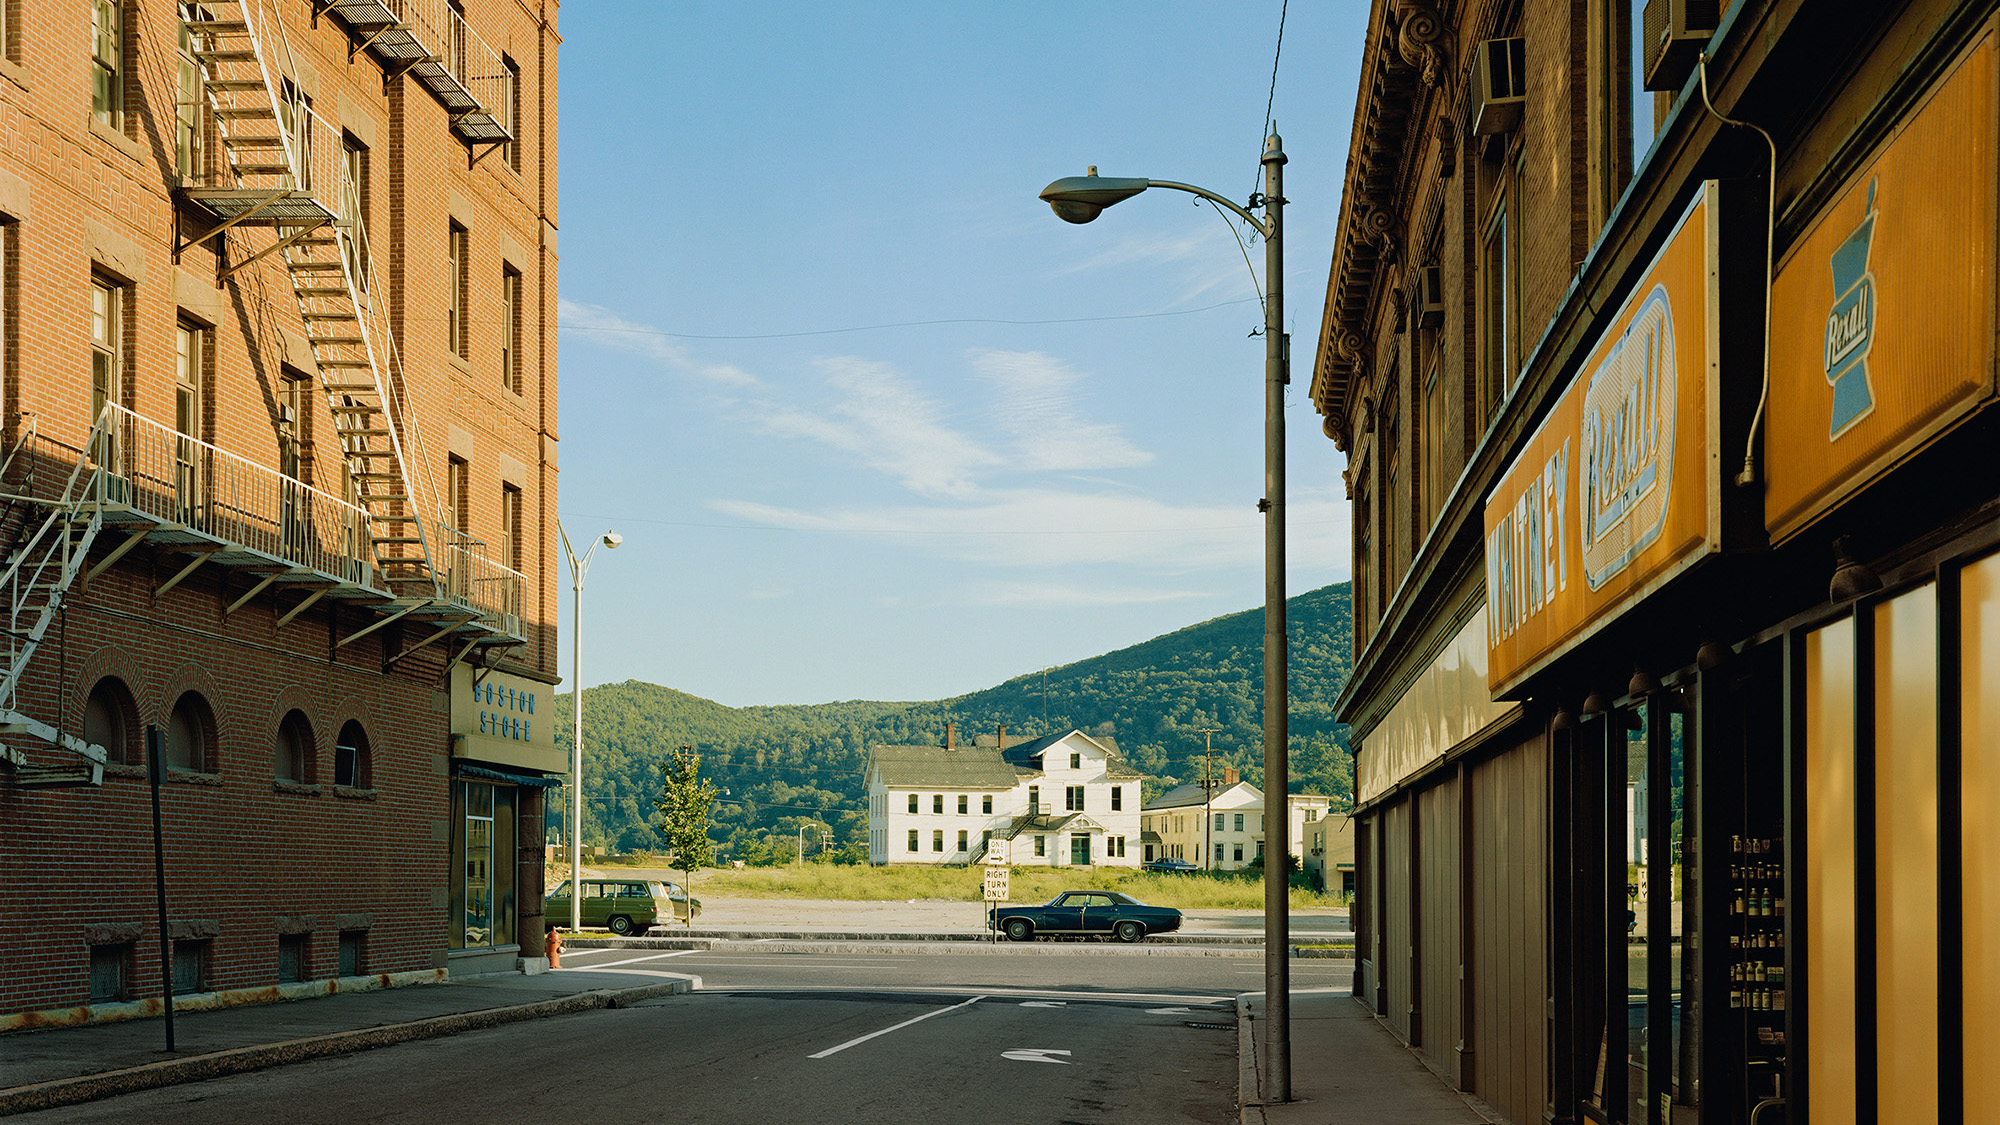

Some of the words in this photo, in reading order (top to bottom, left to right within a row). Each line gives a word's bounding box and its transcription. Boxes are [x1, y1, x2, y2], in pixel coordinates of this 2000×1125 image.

[1826, 283, 1869, 372] Rexall
[1487, 435, 1571, 650] WHITNEY
[1586, 317, 1662, 553] Rexall
[474, 682, 535, 714] BOSTON
[480, 710, 530, 742] STORE
